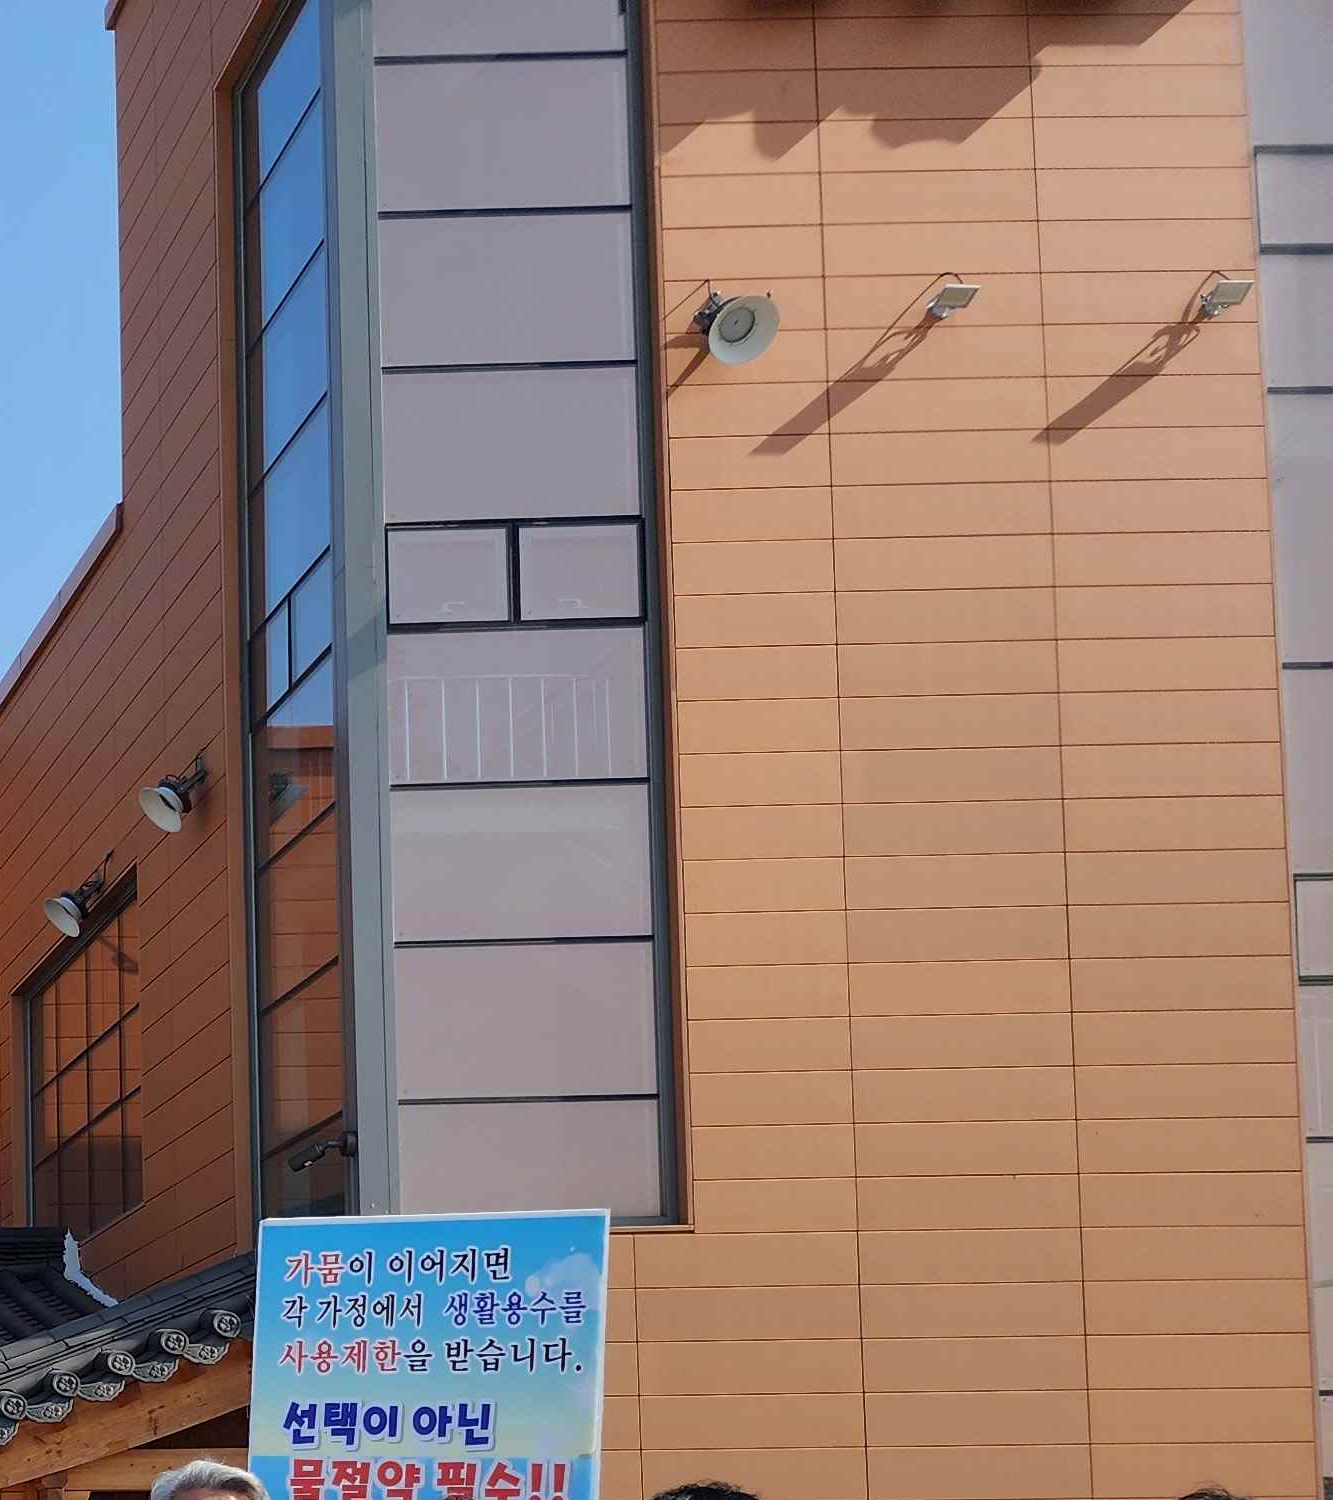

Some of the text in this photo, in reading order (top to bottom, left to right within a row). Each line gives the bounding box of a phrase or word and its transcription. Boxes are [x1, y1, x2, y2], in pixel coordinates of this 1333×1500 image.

[285, 1247, 511, 1286] 가뭄이 이어지면
[283, 1290, 587, 1329] 각 가정에서 생활용수를
[279, 1337, 584, 1374] 사용제한을 받습니다.
[283, 1400, 495, 1446] 선택이 아닌
